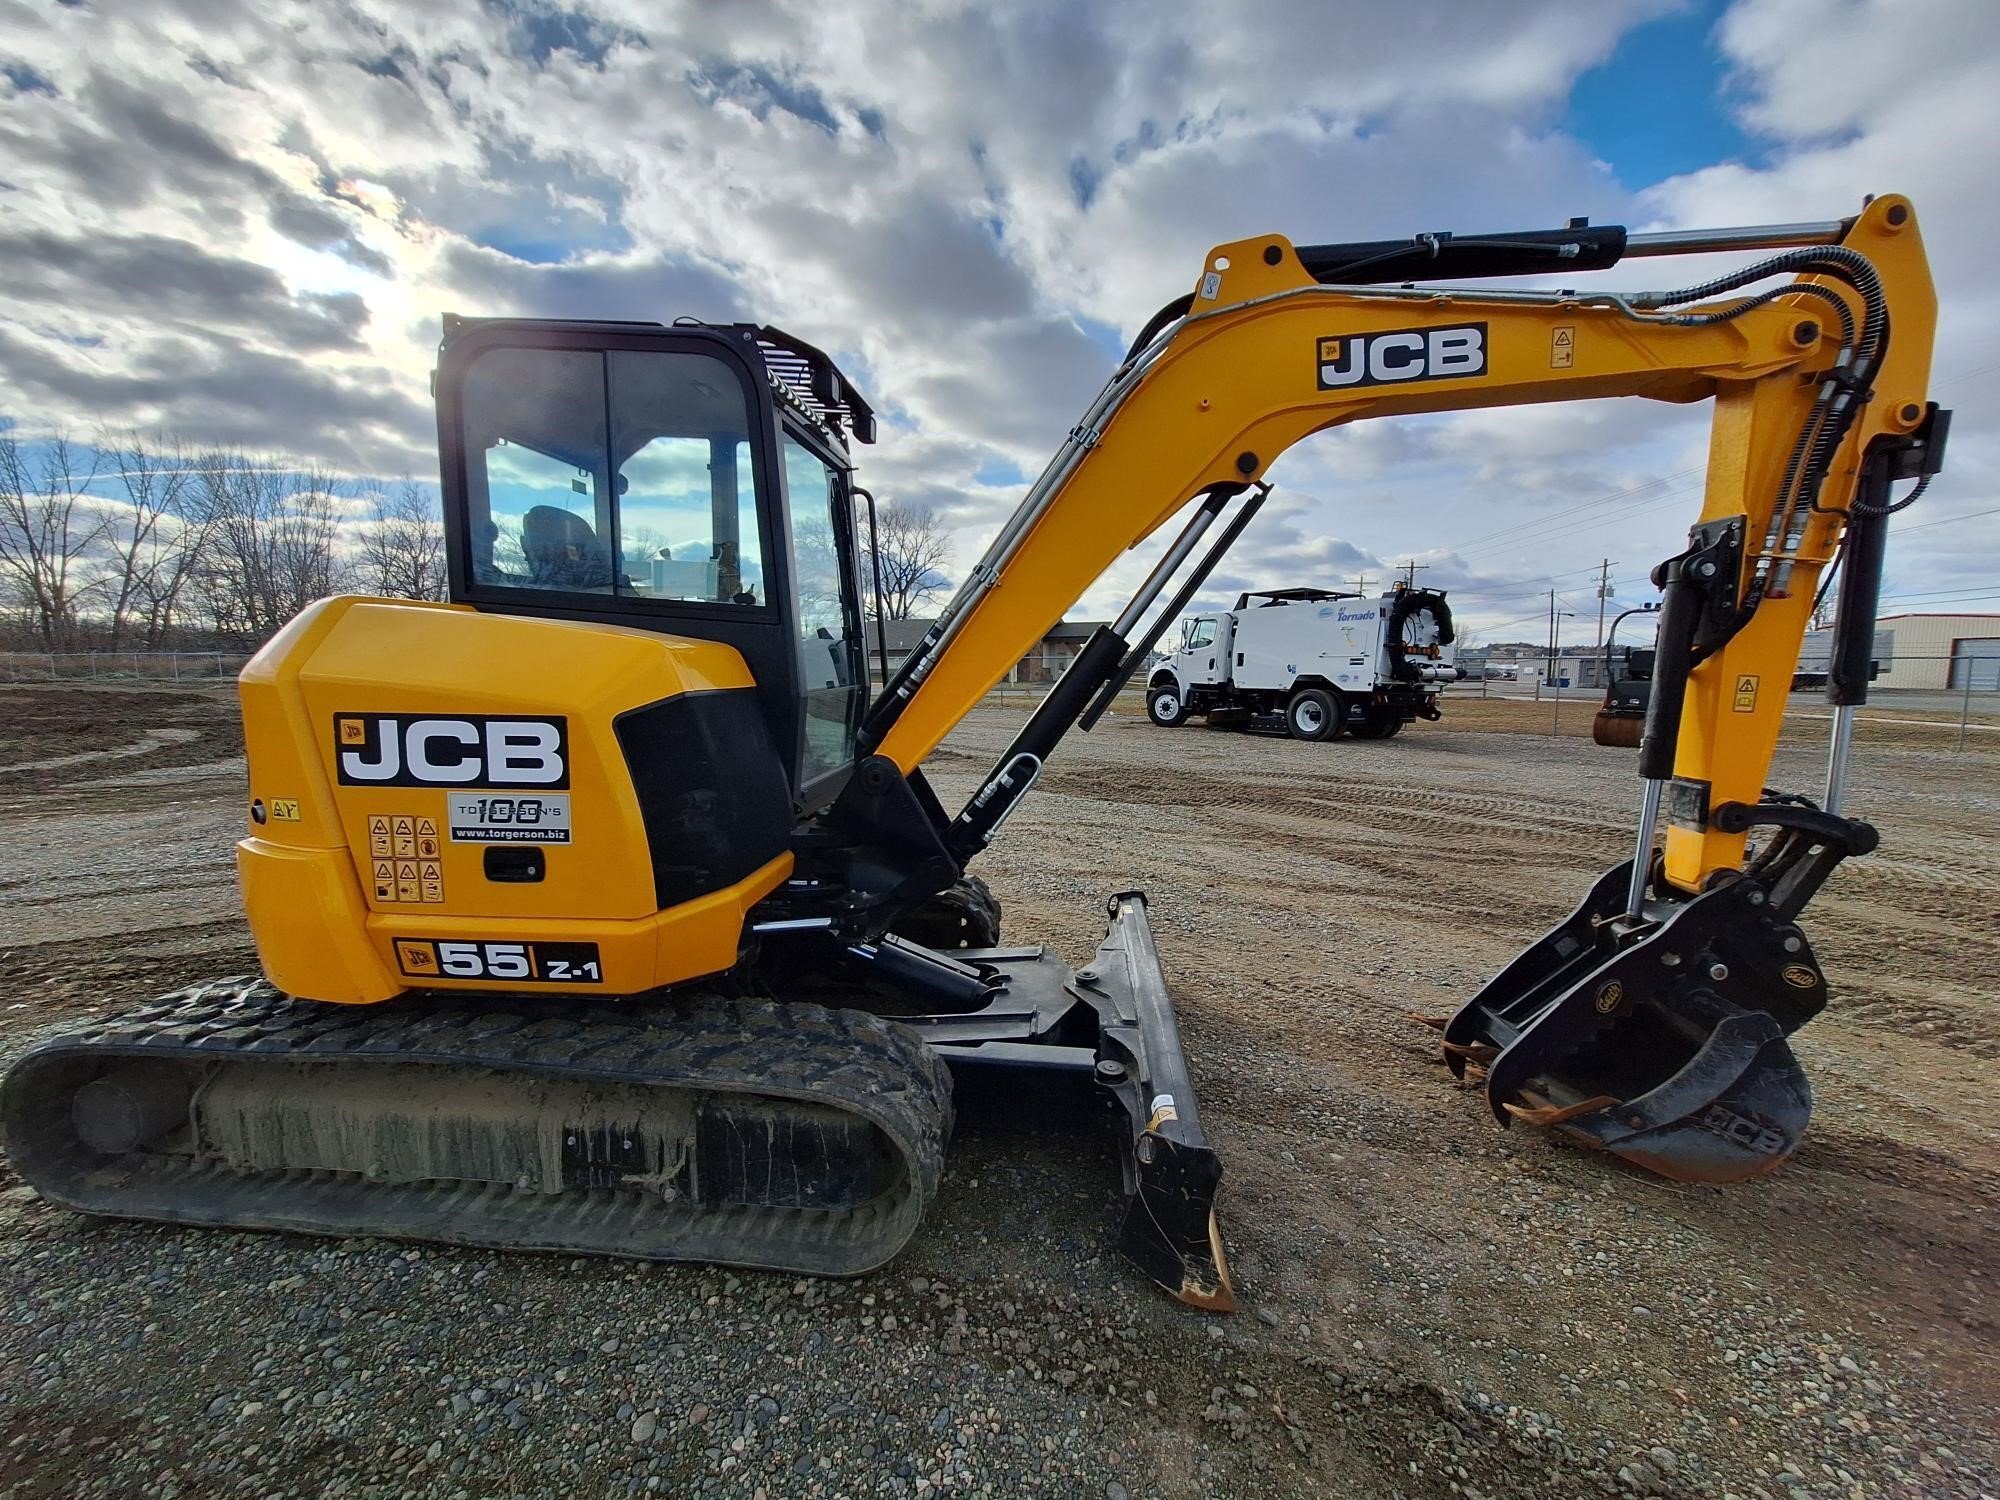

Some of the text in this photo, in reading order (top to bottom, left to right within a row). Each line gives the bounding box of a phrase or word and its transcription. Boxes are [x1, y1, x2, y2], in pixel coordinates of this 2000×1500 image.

[1321, 328, 1484, 385] JCB
[1337, 609, 1375, 621] Tornado
[342, 719, 564, 783] JCB
[458, 806, 561, 816] TORGERSON'S
[477, 799, 543, 824] 100
[456, 829, 566, 840] www.torgerson.biz
[409, 951, 431, 966] JCB
[438, 943, 599, 980] 55 Z-1
